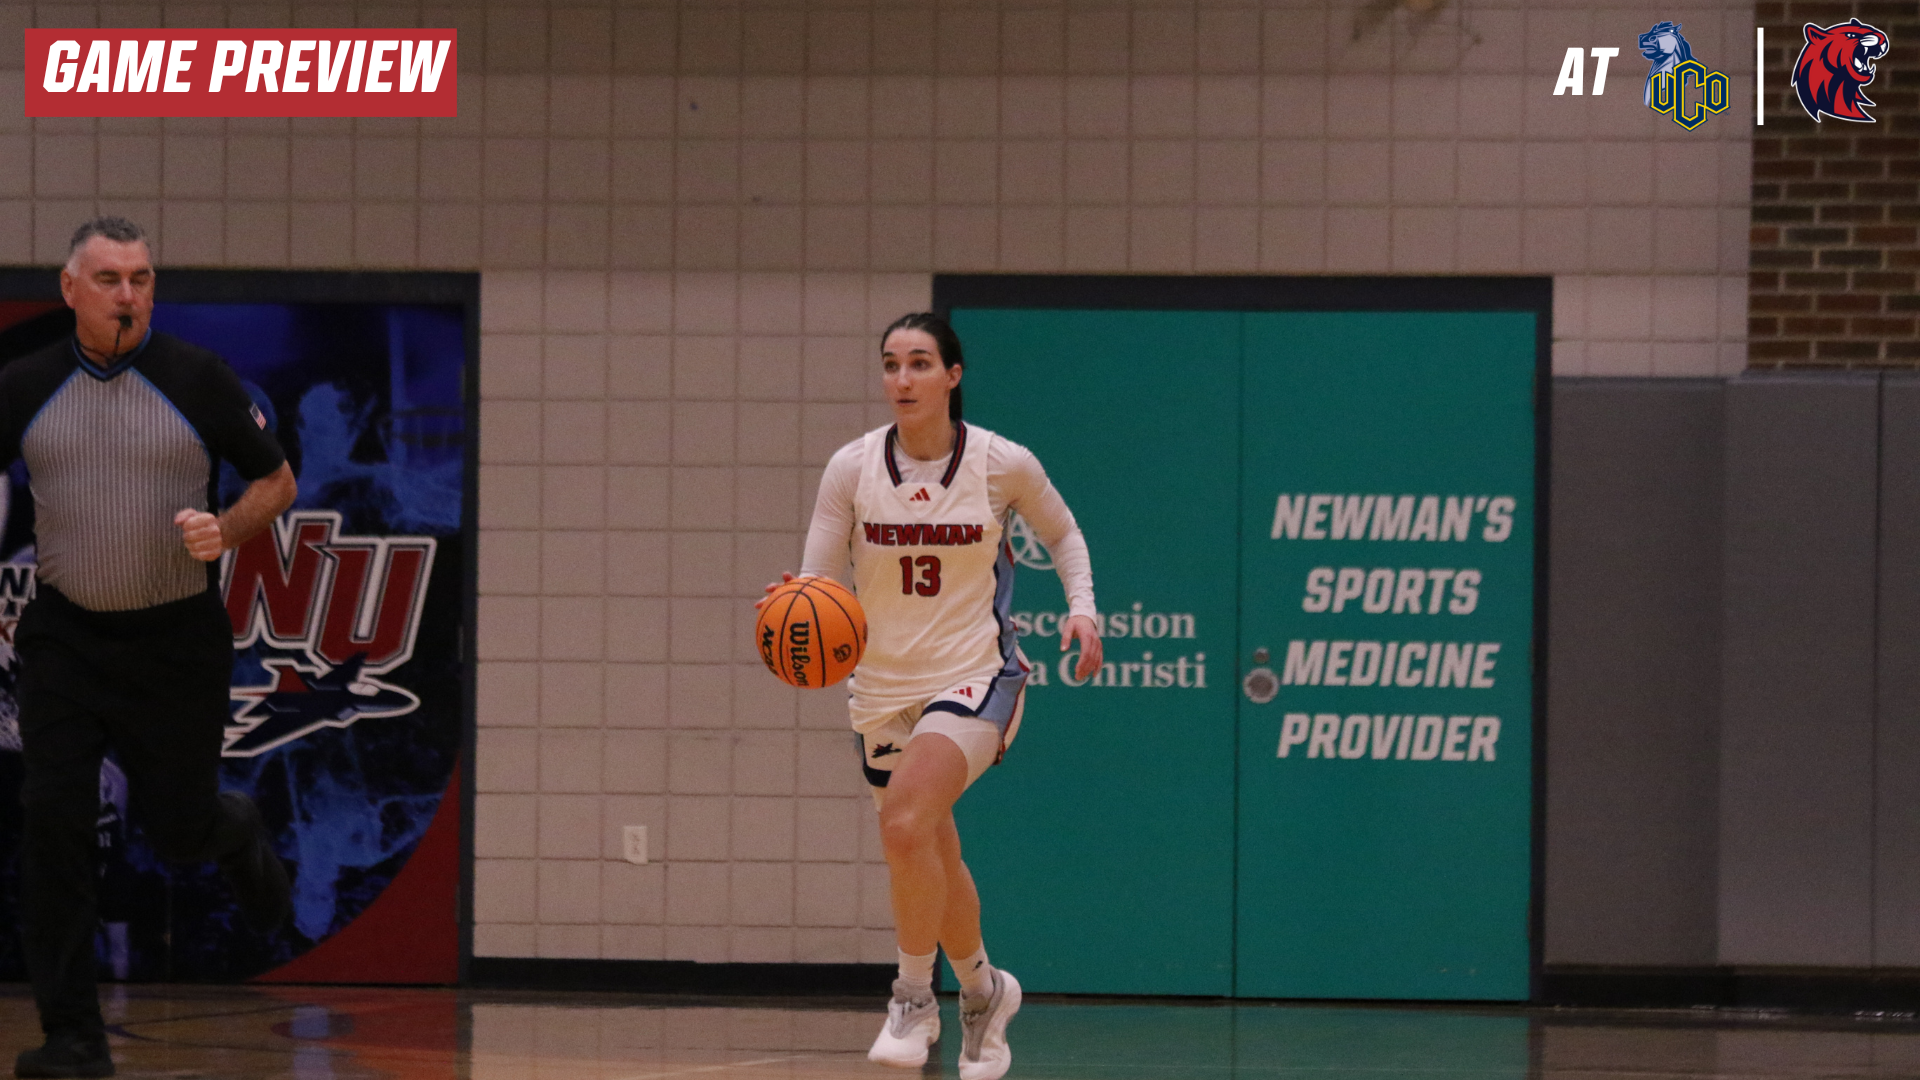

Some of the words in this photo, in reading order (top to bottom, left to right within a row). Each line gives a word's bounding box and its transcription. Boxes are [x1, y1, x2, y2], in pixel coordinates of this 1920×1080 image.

[863, 522, 983, 546] NEWMAN
[1270, 494, 1517, 542] NEWMAN'S
[899, 555, 942, 597] 13
[1302, 566, 1482, 615] SPORTS
[789, 621, 811, 686] Wilson
[1282, 640, 1501, 689] MEDICINE
[1276, 712, 1501, 762] PROVIDER
